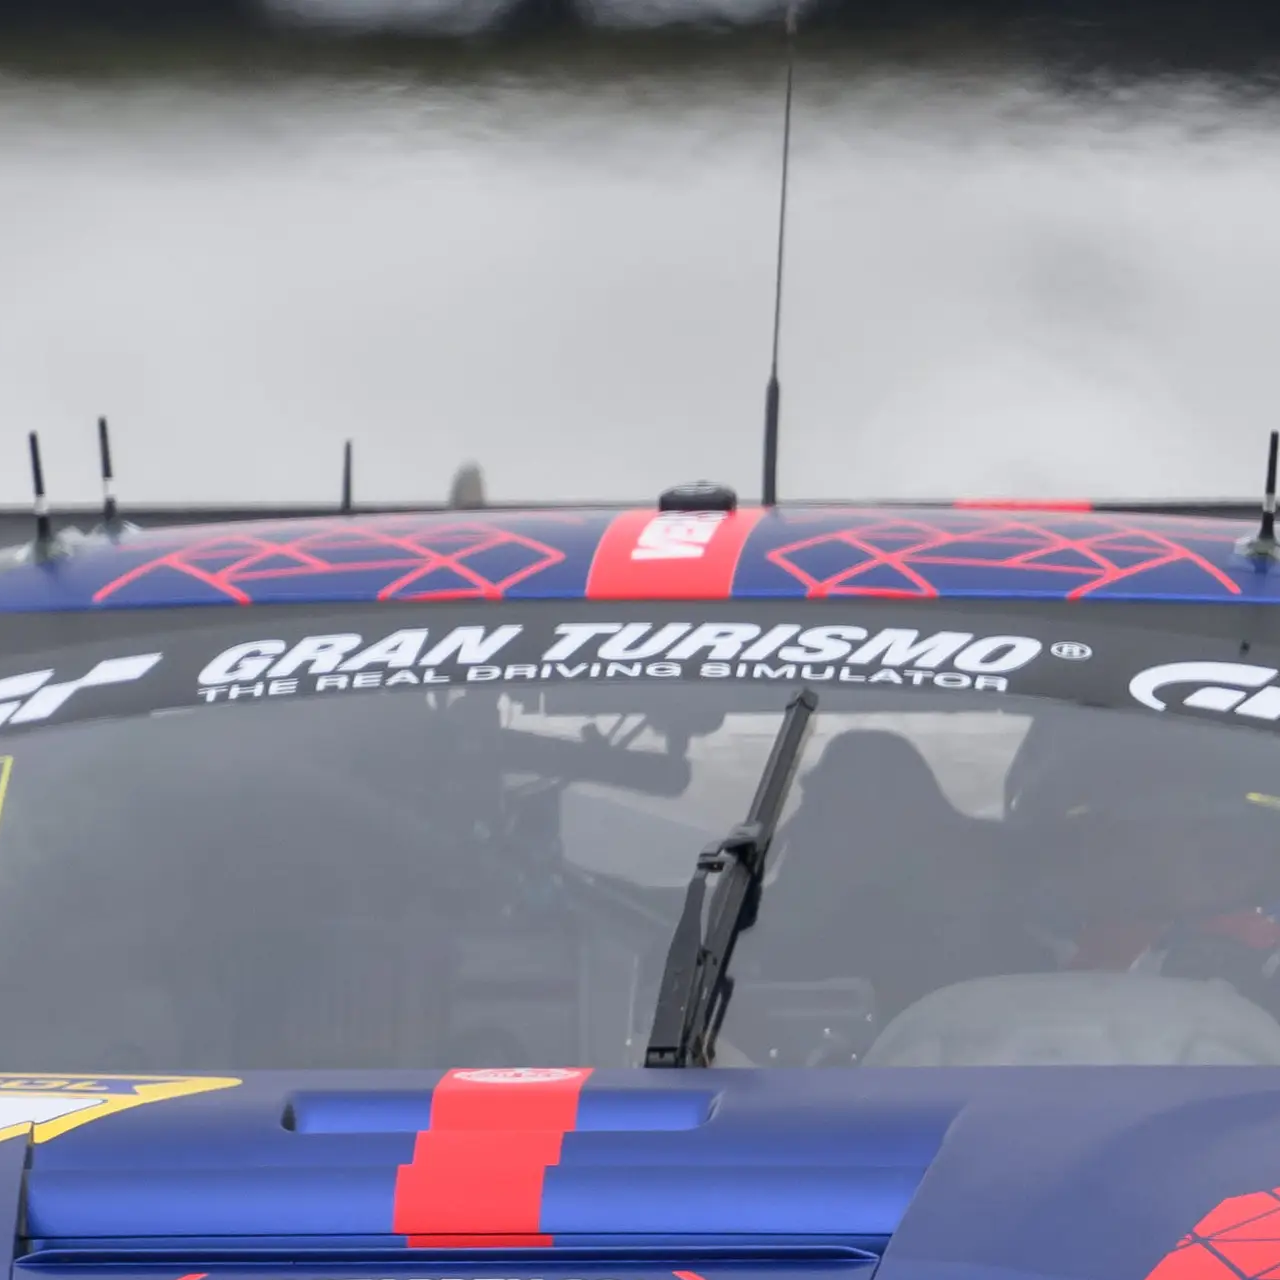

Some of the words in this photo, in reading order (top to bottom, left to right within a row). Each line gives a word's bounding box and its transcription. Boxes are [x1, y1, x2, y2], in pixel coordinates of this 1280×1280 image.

[198, 624, 523, 685] GRAN
[541, 622, 1041, 672] TURISMO
[198, 677, 298, 702] THE
[315, 669, 451, 692] REAL
[466, 662, 681, 683] DRIVING
[700, 663, 1008, 692] SIMULATOR
